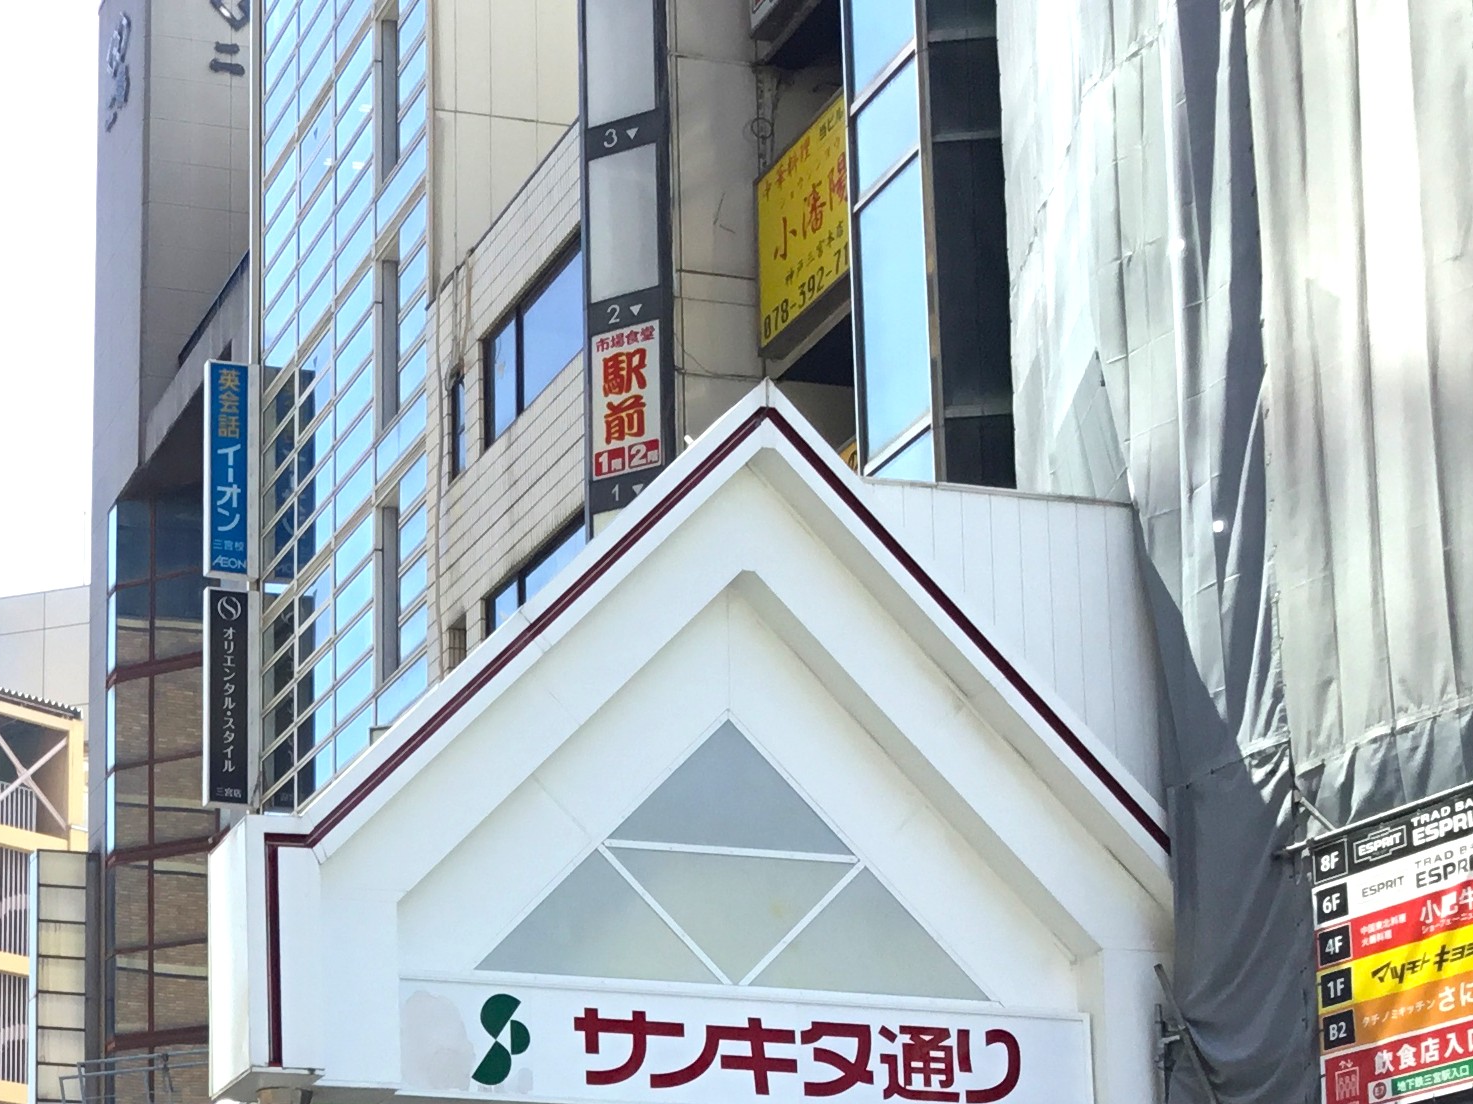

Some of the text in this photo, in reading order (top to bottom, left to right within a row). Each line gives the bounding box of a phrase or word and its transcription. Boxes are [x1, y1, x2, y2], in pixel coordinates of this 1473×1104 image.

[603, 128, 618, 148] 3
[607, 304, 620, 324] 2
[596, 325, 655, 352] 市場食堂
[602, 347, 647, 445] 駅前
[217, 443, 241, 532] イーオン
[611, 484, 620, 501] 1
[222, 627, 237, 773] オリエンタル・スタイル
[1411, 805, 1452, 827] TRAD
[1357, 832, 1402, 857] ESPRIT
[1320, 851, 1339, 872] 8F
[1415, 850, 1454, 869] TRAD
[1361, 875, 1405, 898] ESPRIT
[1322, 893, 1341, 914] 6F
[1325, 935, 1343, 955] 4F
[1328, 978, 1345, 999] 1F
[1329, 1021, 1347, 1041] B2
[573, 1006, 1023, 1104] サンキタ通り
